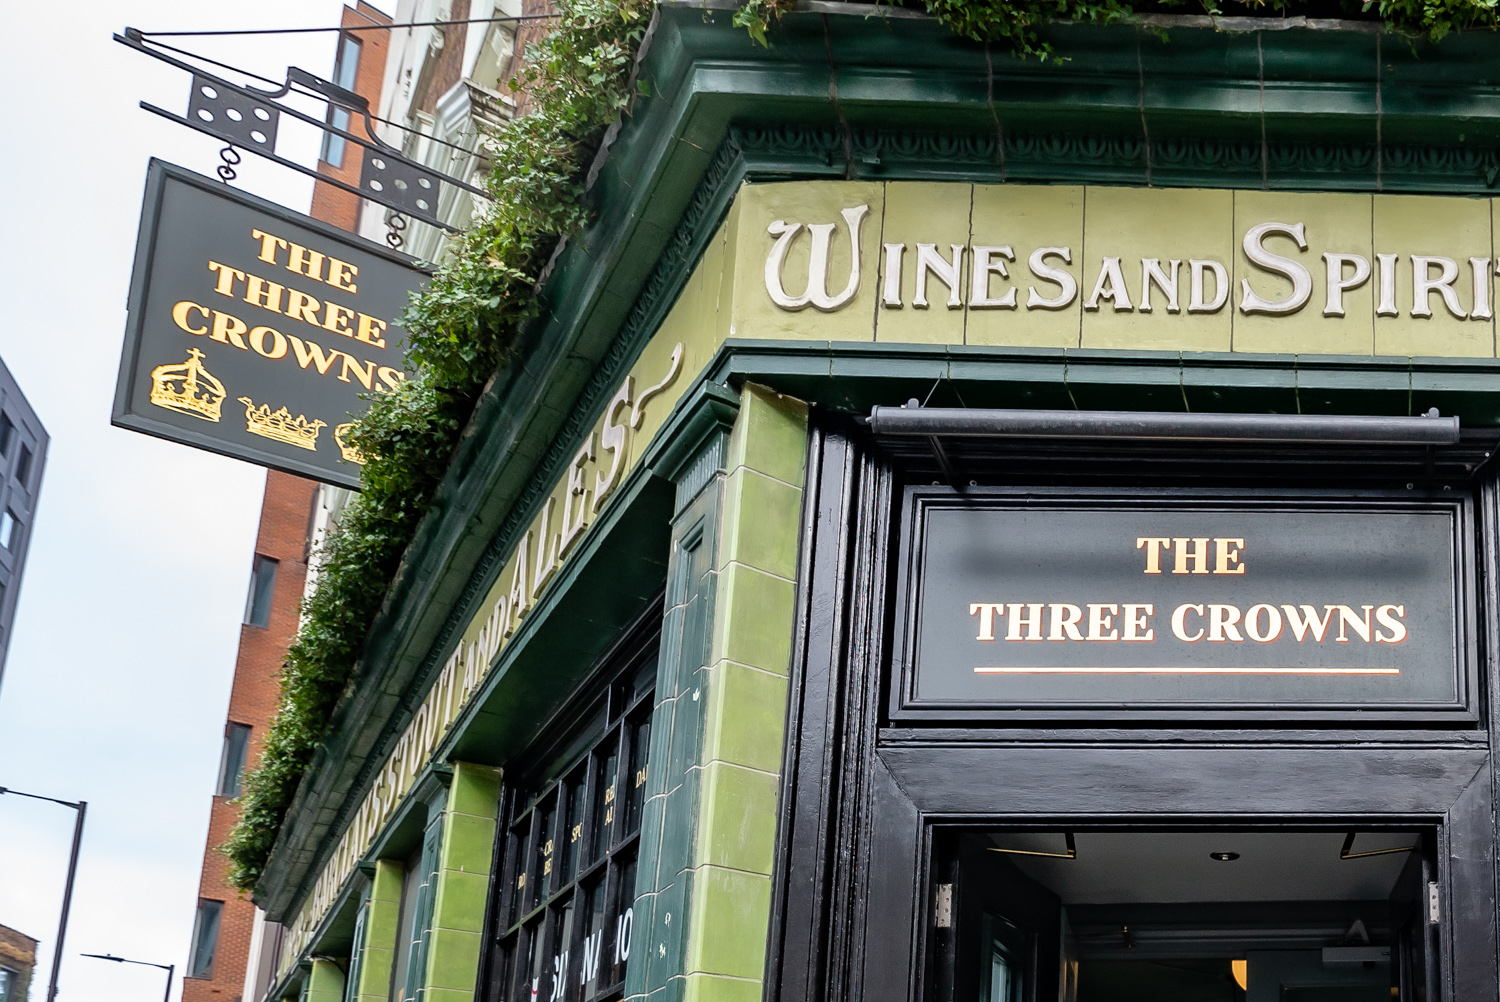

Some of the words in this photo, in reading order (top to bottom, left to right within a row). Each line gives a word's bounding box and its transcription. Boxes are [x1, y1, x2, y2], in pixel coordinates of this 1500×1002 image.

[252, 228, 360, 294] THE
[763, 203, 1079, 313] WINES
[1083, 255, 1231, 316] AND
[172, 300, 406, 394] CROWNS
[208, 260, 388, 350] THREE
[382, 639, 465, 822] STOUT
[460, 595, 510, 708] AND
[506, 376, 635, 636] ALES
[1136, 536, 1246, 576] THE
[969, 602, 1155, 643] THREE
[1170, 602, 1408, 645] CROWNS
